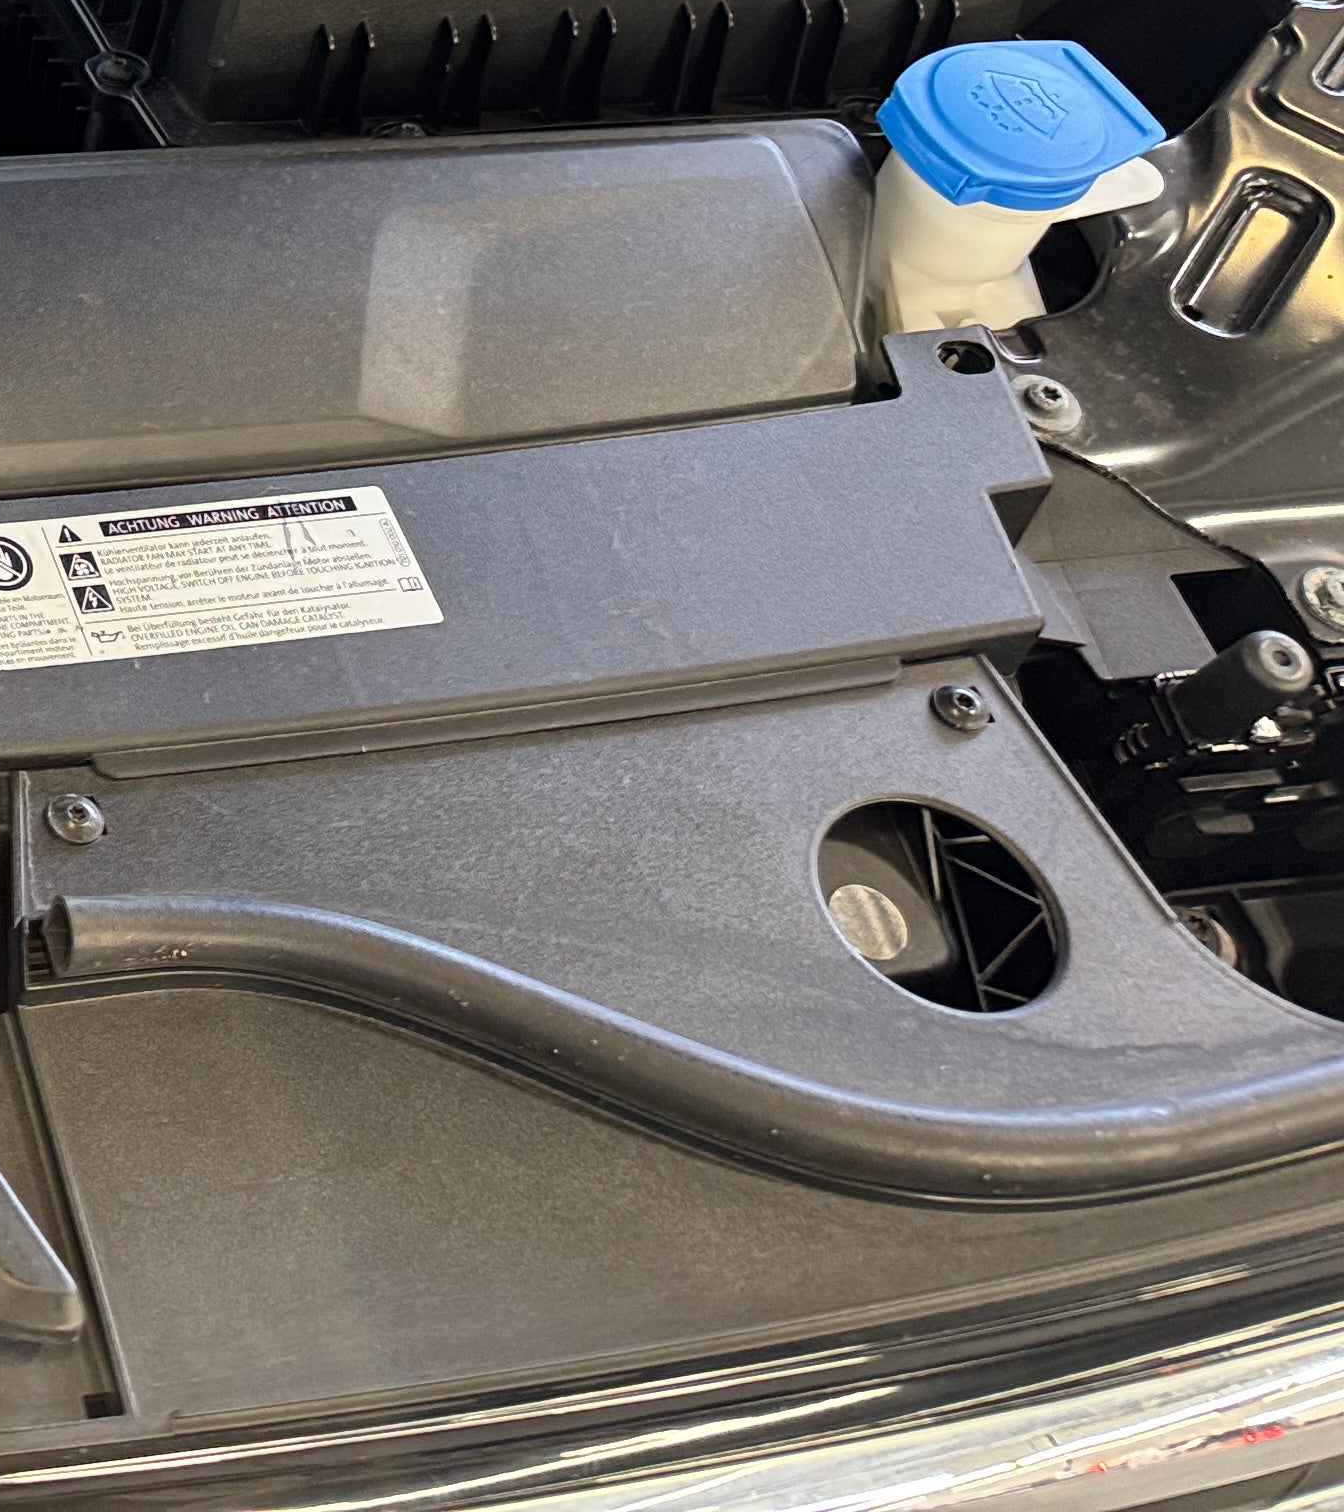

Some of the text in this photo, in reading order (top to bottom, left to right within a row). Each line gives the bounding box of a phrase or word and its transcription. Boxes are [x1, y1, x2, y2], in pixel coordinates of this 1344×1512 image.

[109, 499, 346, 534] ACHTUNG WARNING ATTENTION
[100, 554, 145, 566] RADIATOR
[145, 552, 165, 561] FAN
[164, 550, 186, 559] MAY
[186, 546, 213, 557] START
[216, 545, 226, 554] AT
[228, 543, 247, 552] ANY
[112, 558, 396, 596] HIGH SWITCH OFF ENGINE BEFORE TOUCHING IGNITION
[130, 629, 184, 643] OVERFILLED
[184, 625, 220, 637] ENGINE
[238, 621, 260, 631] CAN
[259, 615, 301, 628] DAMAGE
